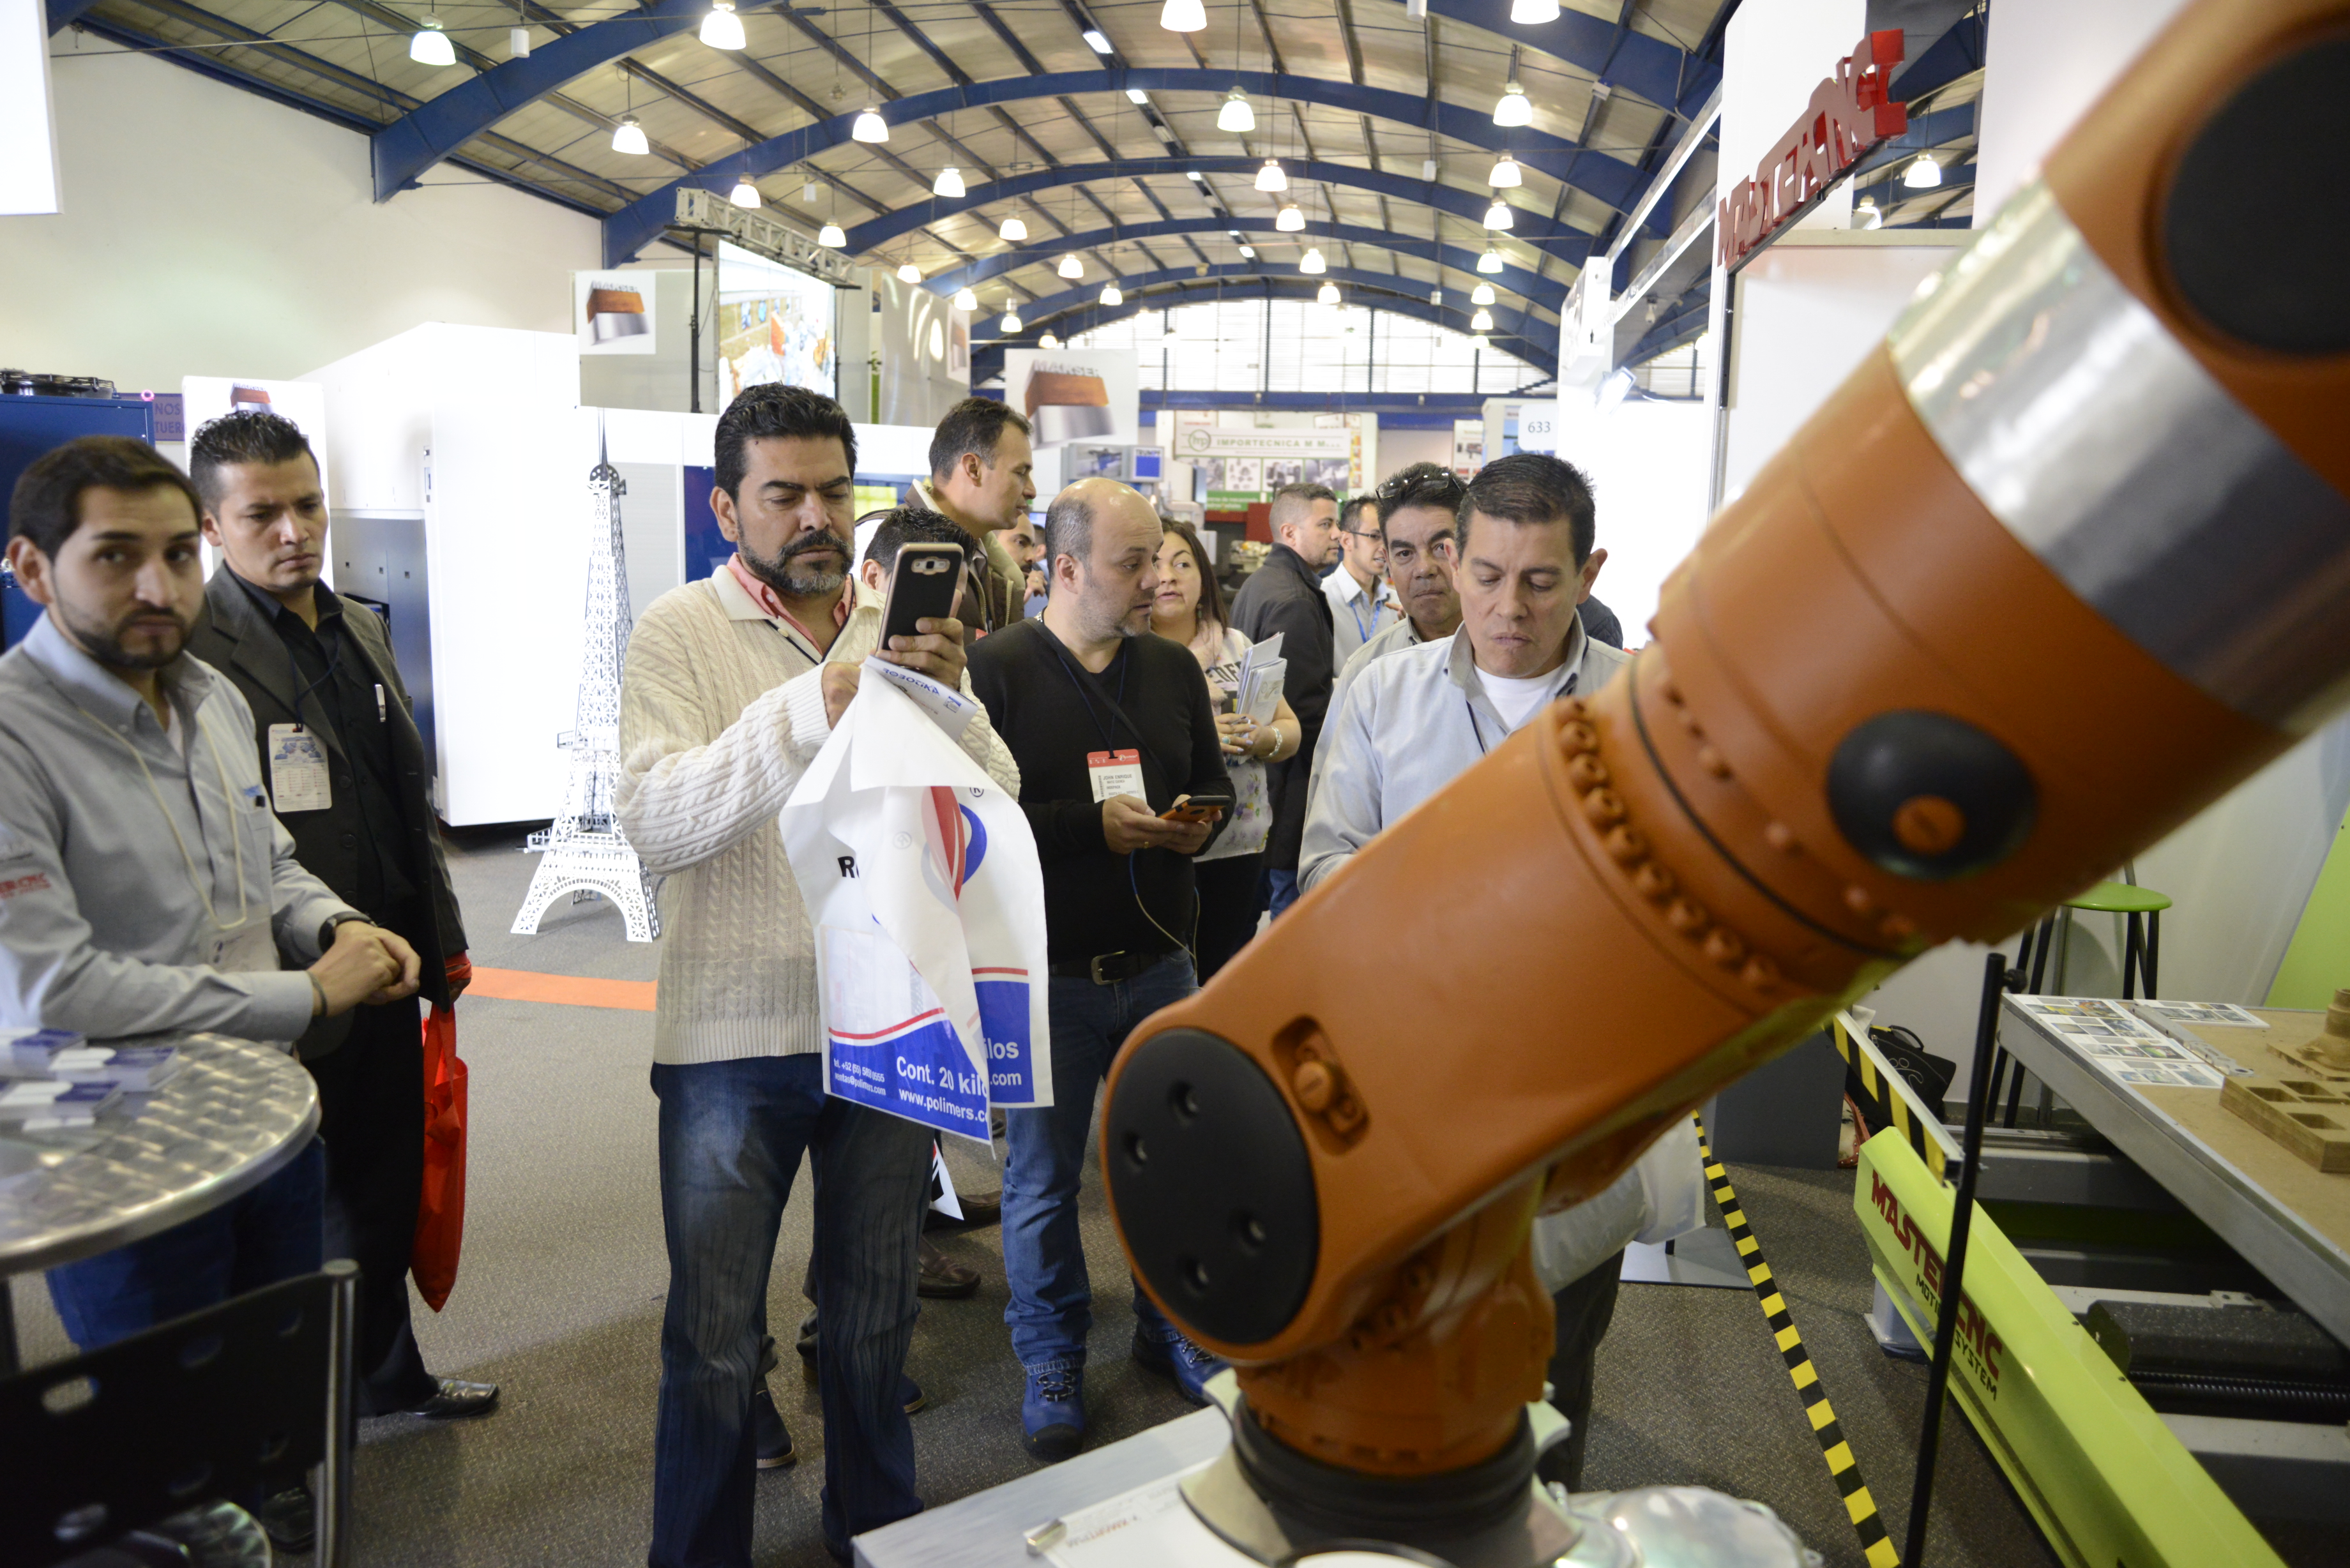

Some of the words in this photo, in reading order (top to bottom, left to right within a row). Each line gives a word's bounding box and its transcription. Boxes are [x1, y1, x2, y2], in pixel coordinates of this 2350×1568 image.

[1528, 421, 1550, 433] 633
[1217, 438, 1300, 447] IMPORTECNICA
[842, 1062, 852, 1071] +52
[897, 1056, 935, 1085] Cont.
[939, 1067, 954, 1091] 20
[1955, 1329, 1997, 1401] SYSTEM
